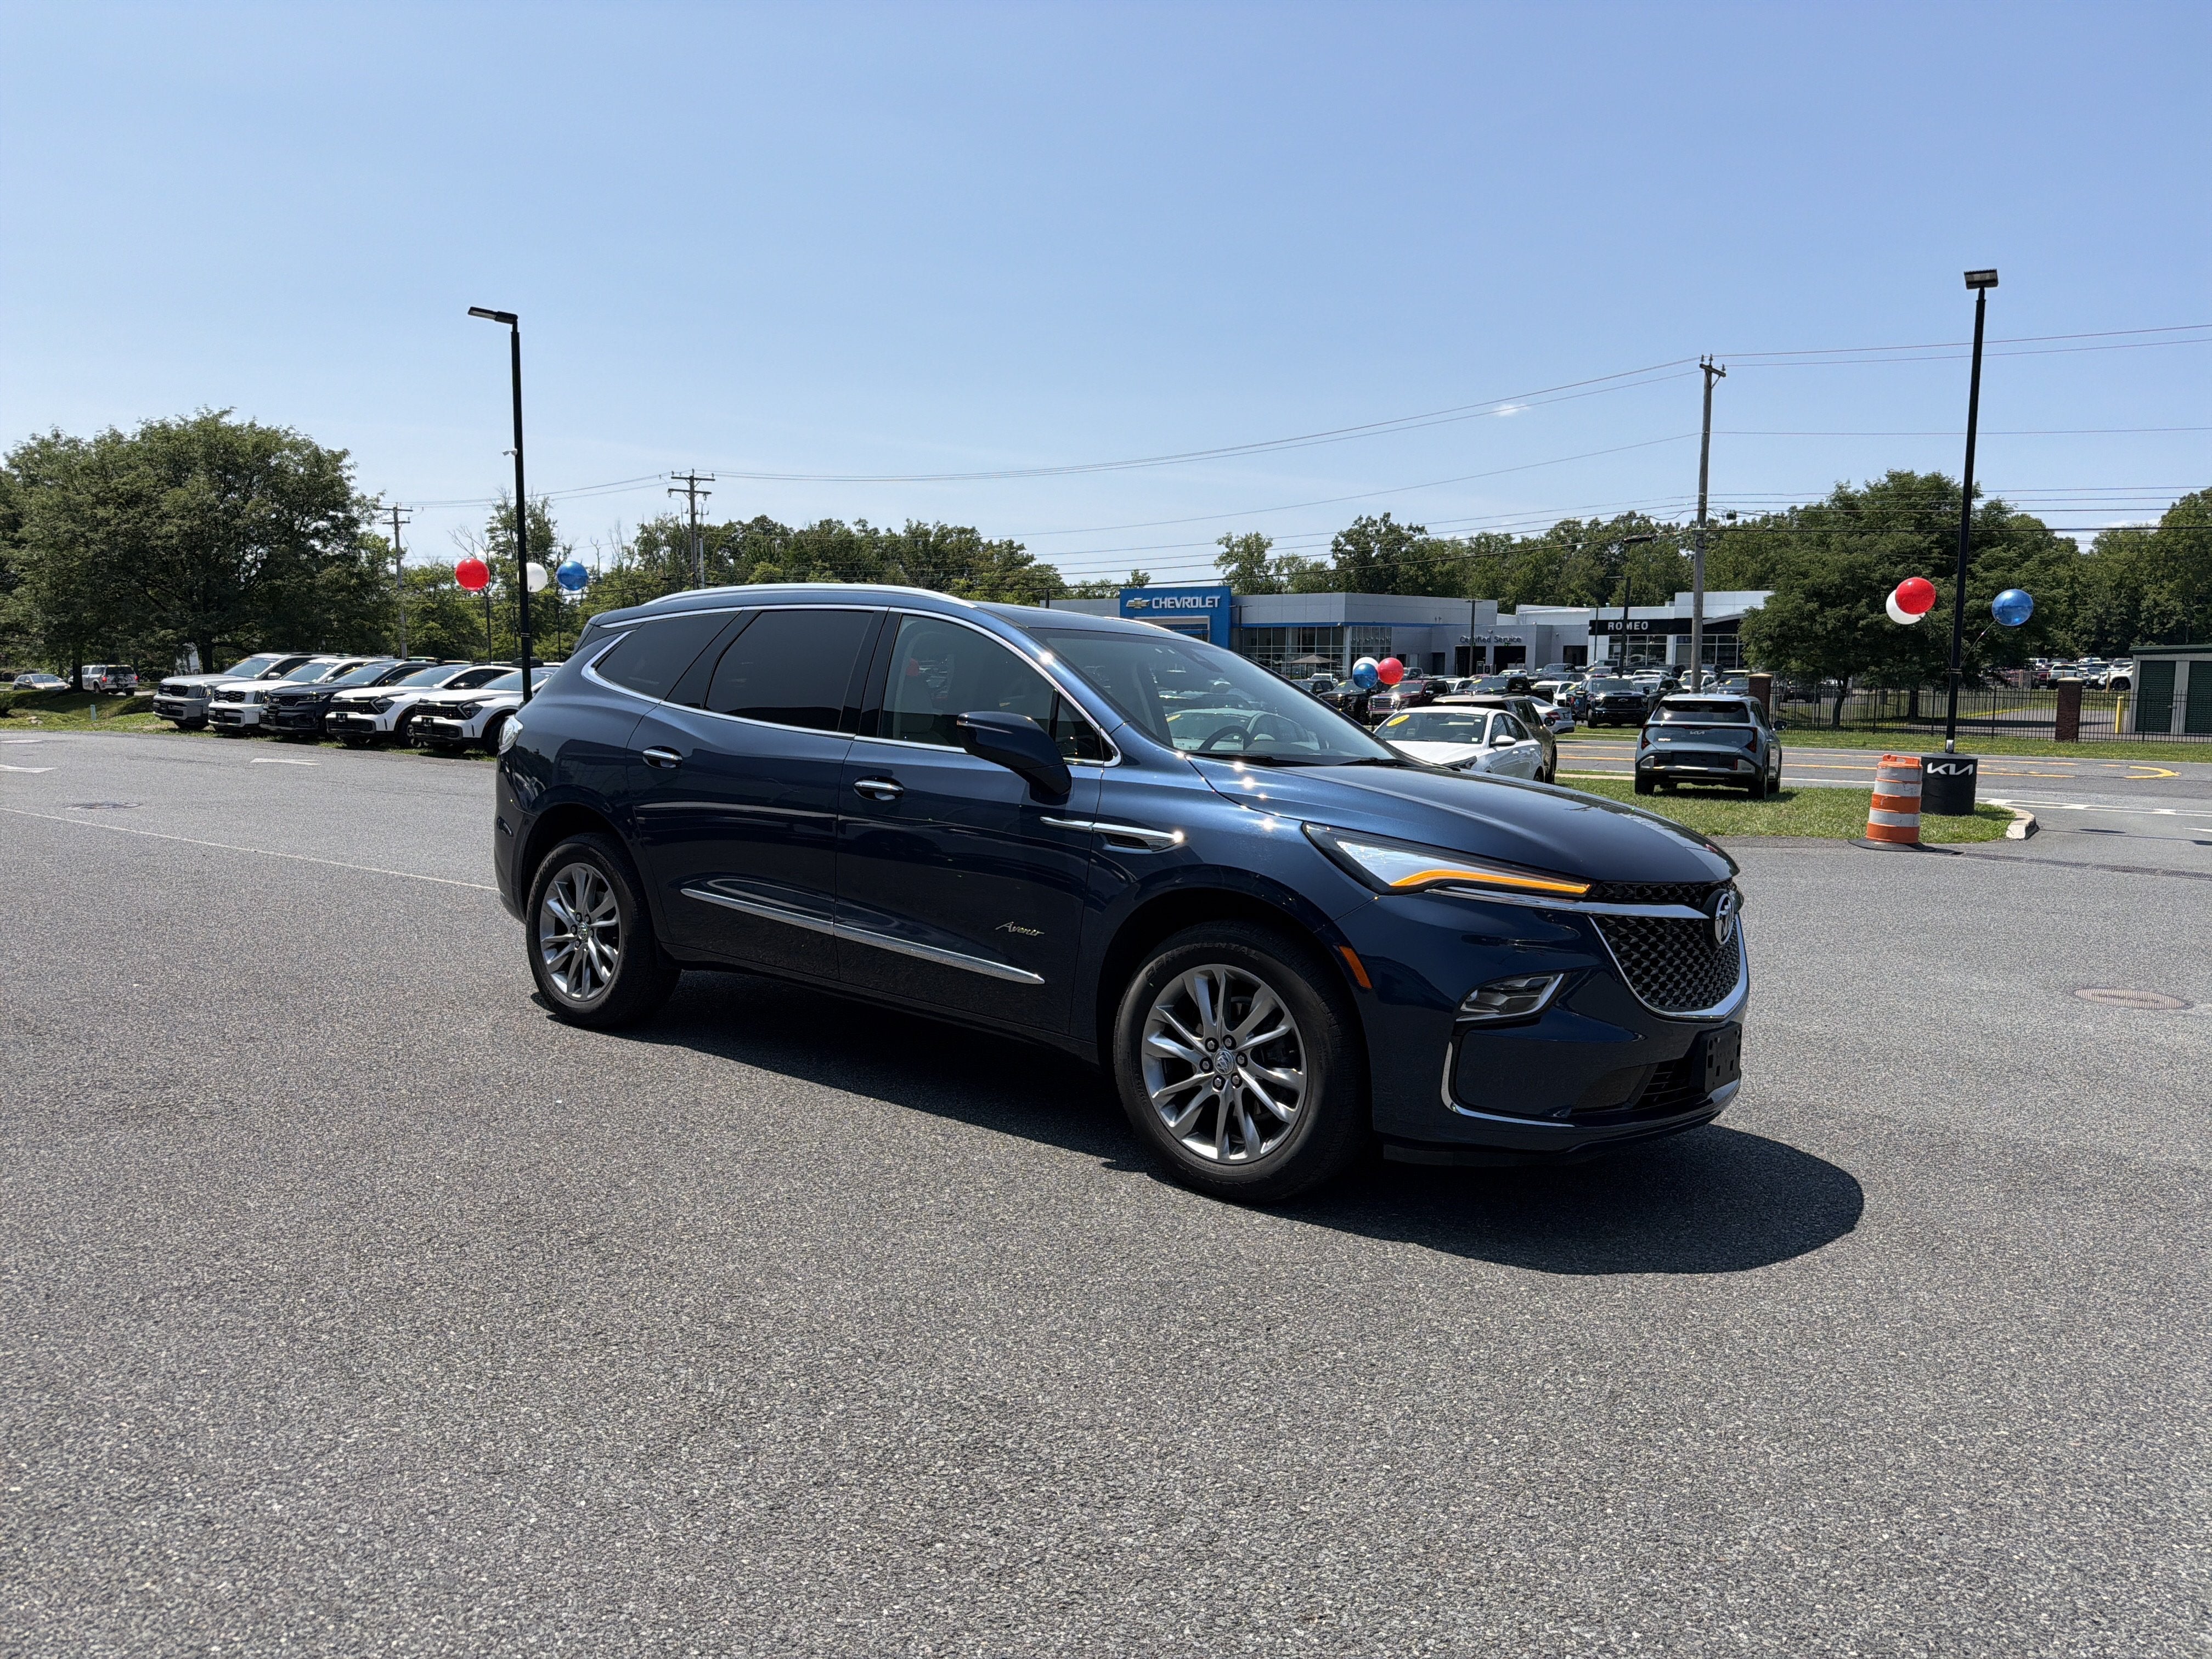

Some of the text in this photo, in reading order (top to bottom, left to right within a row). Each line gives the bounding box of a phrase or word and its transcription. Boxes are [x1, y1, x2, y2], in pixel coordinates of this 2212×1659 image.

[1152, 596, 1220, 608] CHEVROLET
[1607, 621, 1649, 630] ROMEO
[1927, 762, 1973, 776] KIA
